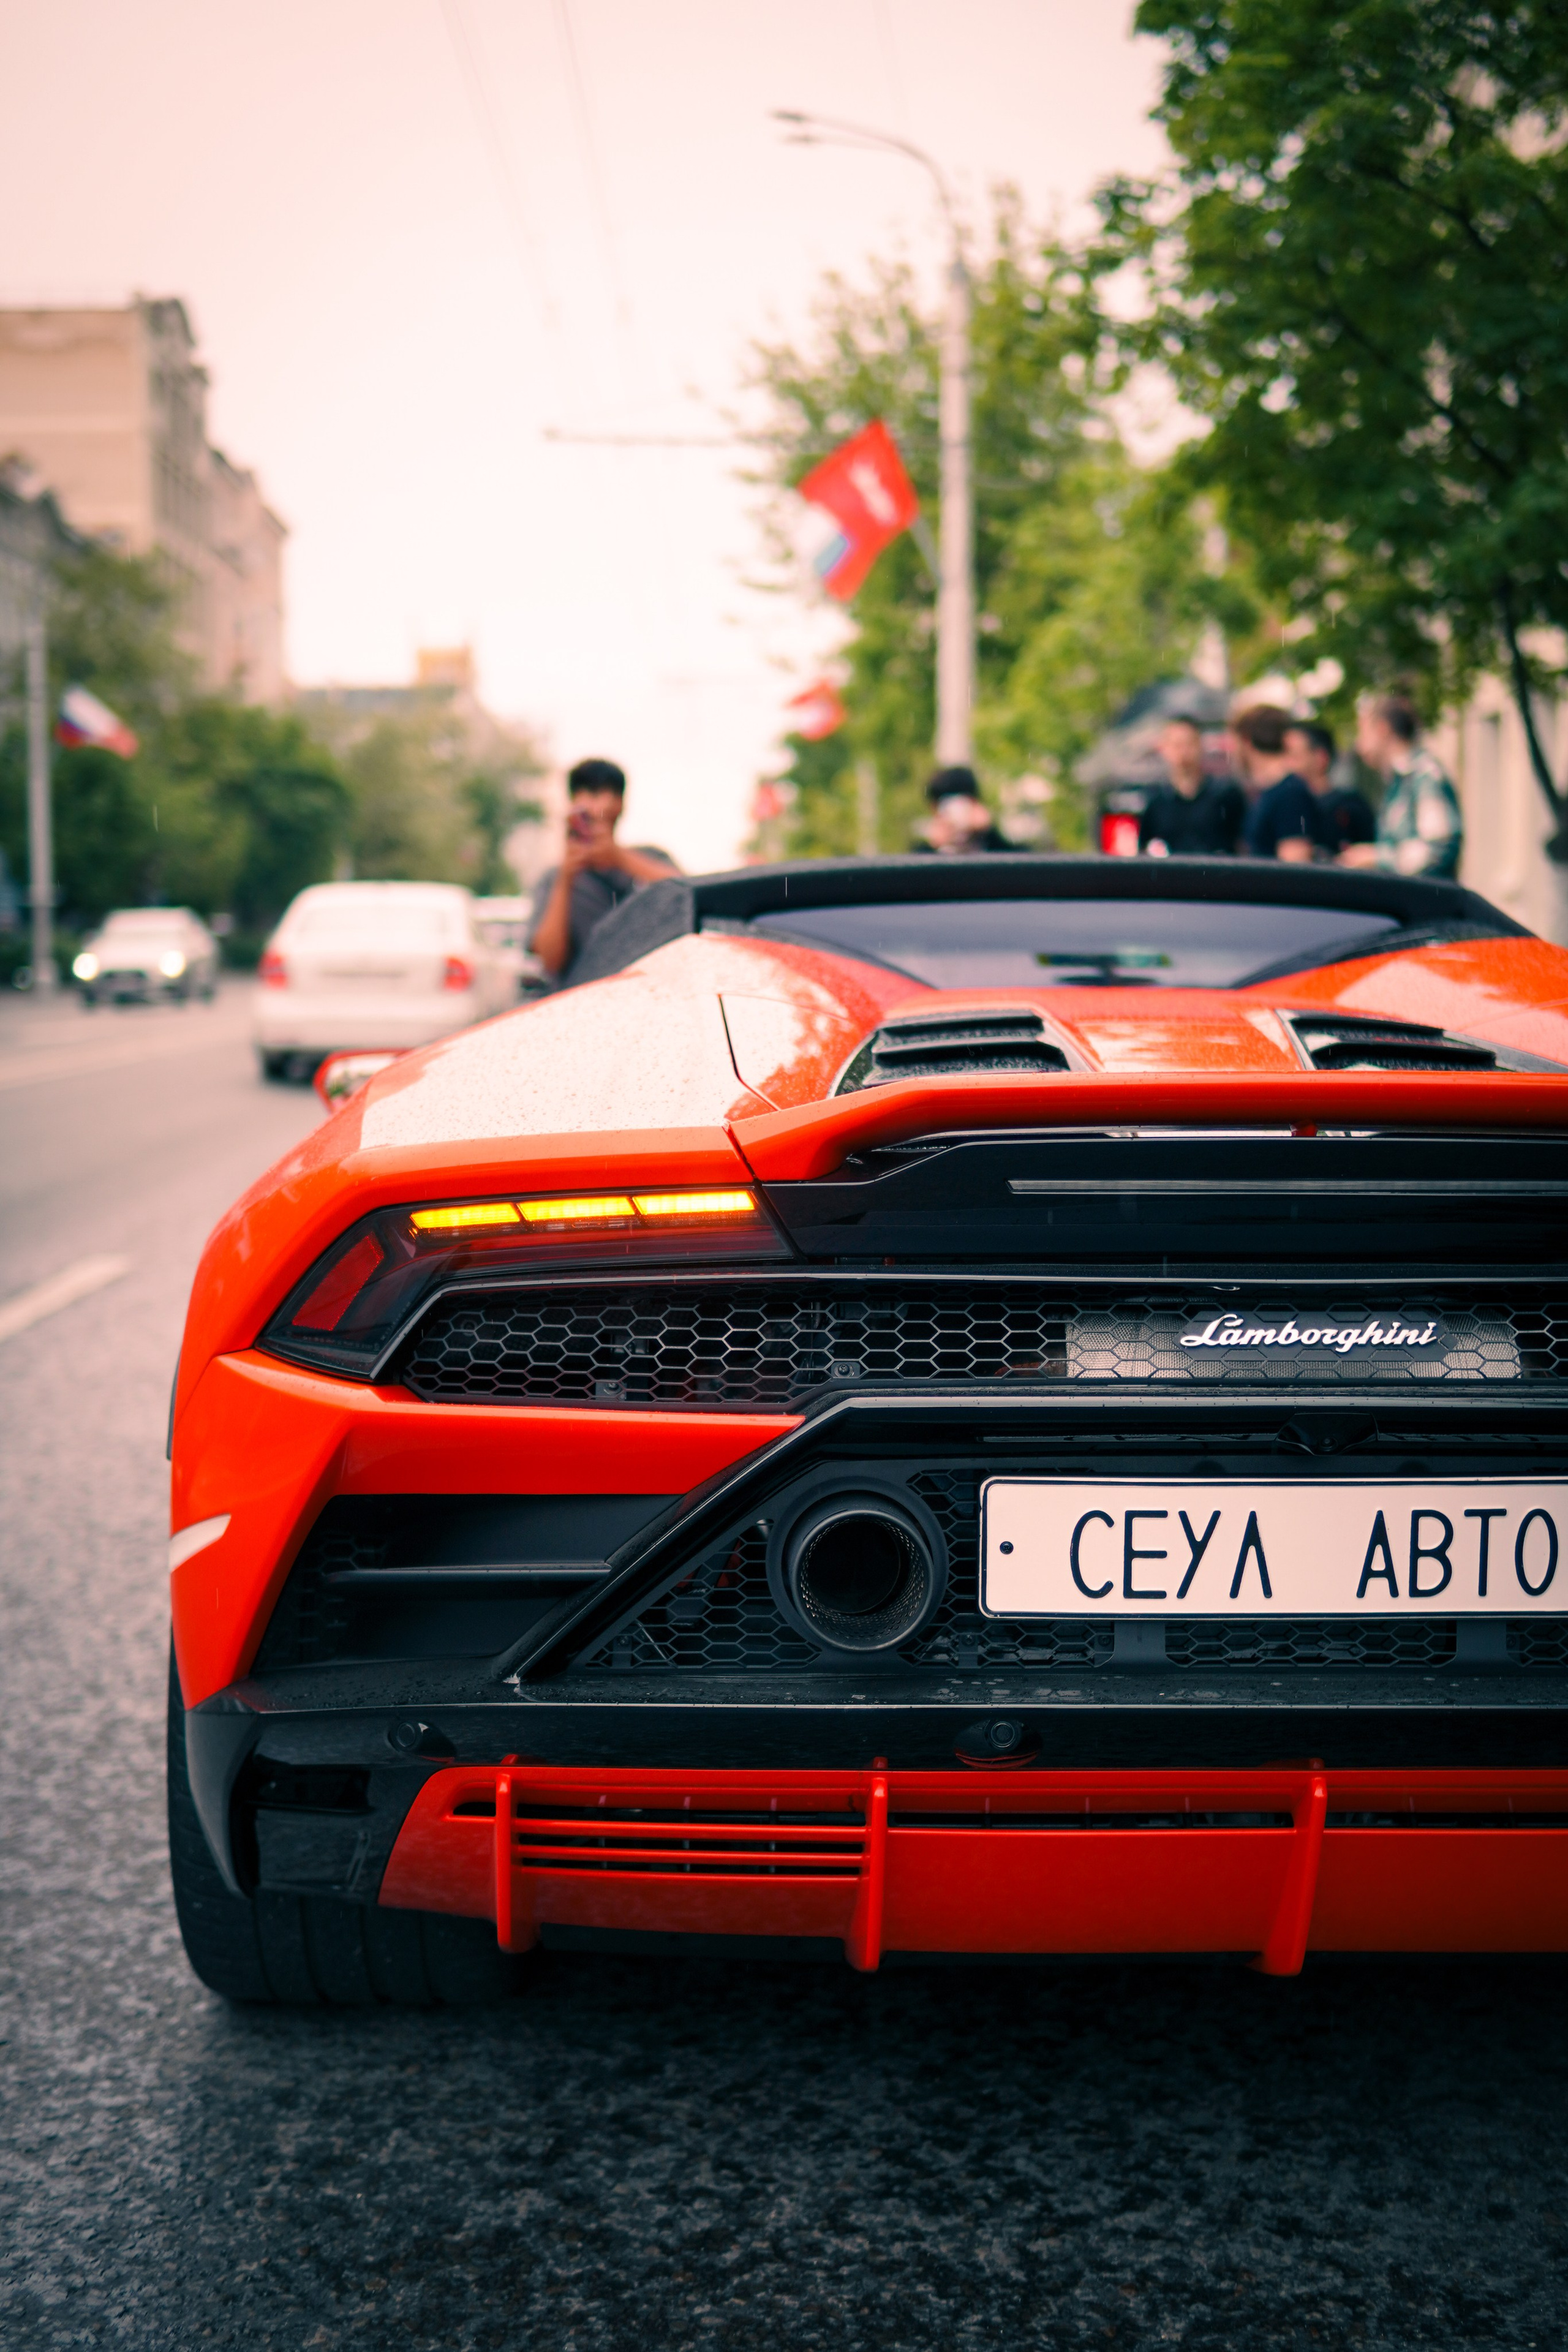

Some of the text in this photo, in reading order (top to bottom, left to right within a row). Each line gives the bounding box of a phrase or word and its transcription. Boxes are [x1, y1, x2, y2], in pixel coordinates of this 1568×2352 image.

[1180, 1313, 1438, 1353] Lamborghini
[1069, 1507, 1558, 1599] СЕУЛ АВТО
